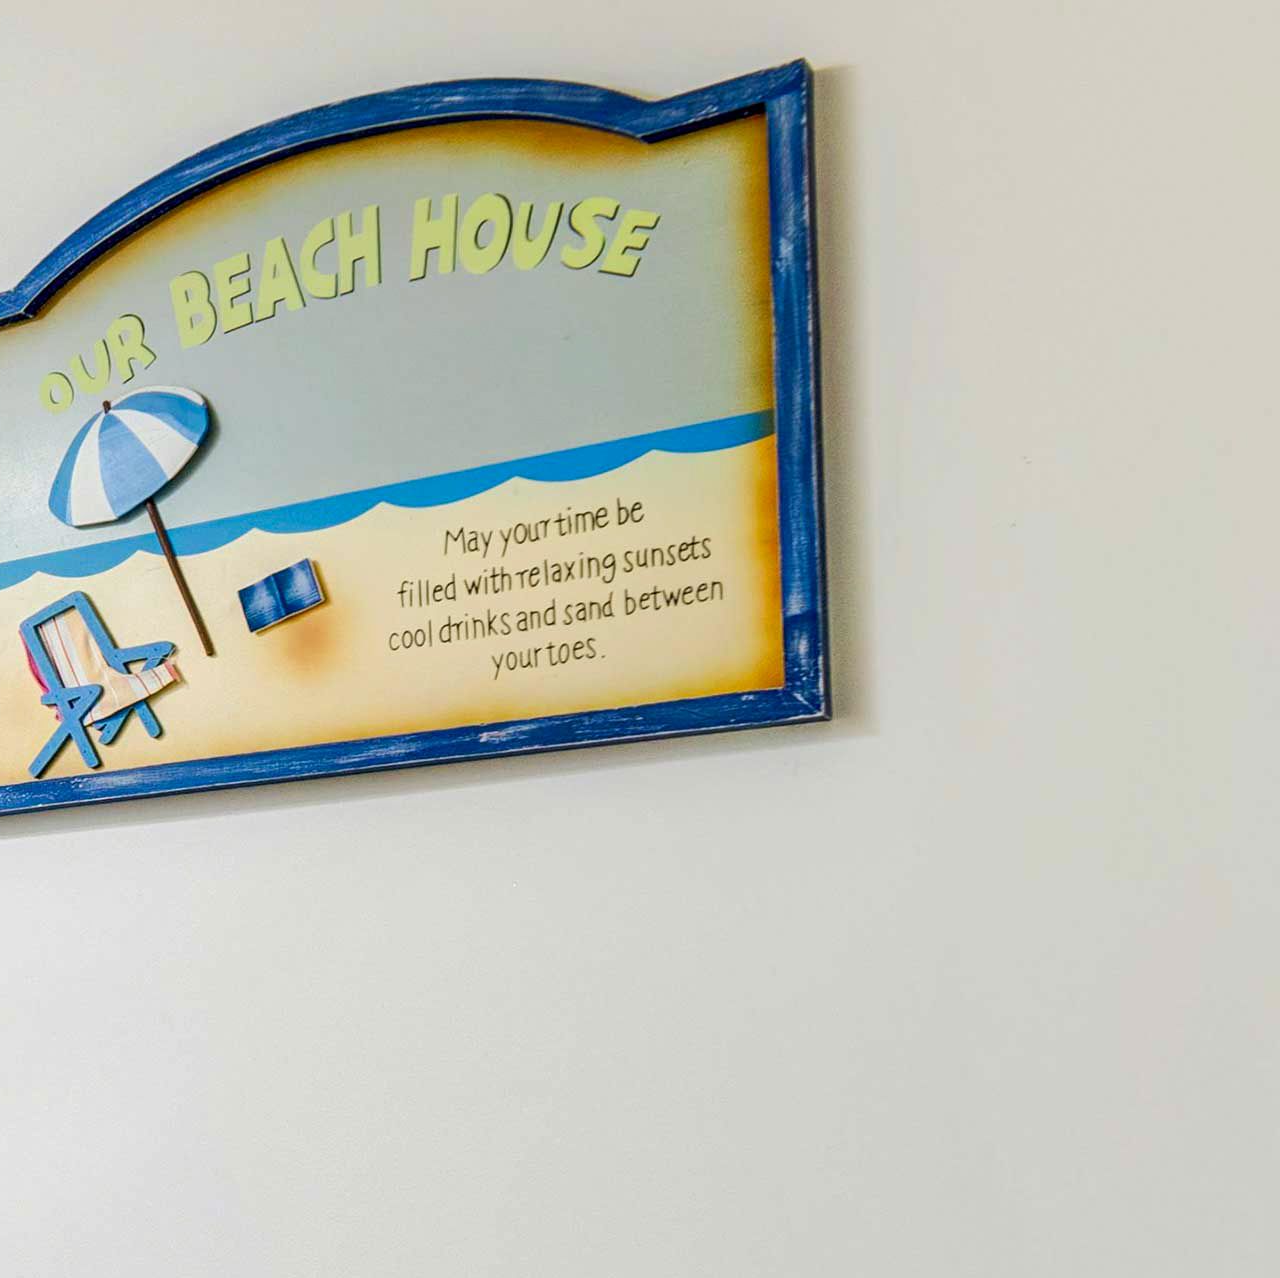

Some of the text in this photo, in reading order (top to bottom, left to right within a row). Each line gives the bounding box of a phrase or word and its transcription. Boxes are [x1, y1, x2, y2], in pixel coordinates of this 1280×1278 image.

[40, 193, 661, 414] OUR BEACH HOUSE
[444, 497, 645, 558] May your time be
[397, 535, 712, 607] filled with relaxing sunsets
[388, 579, 724, 651] cool drinks and sand between
[491, 636, 607, 681] your toes.
